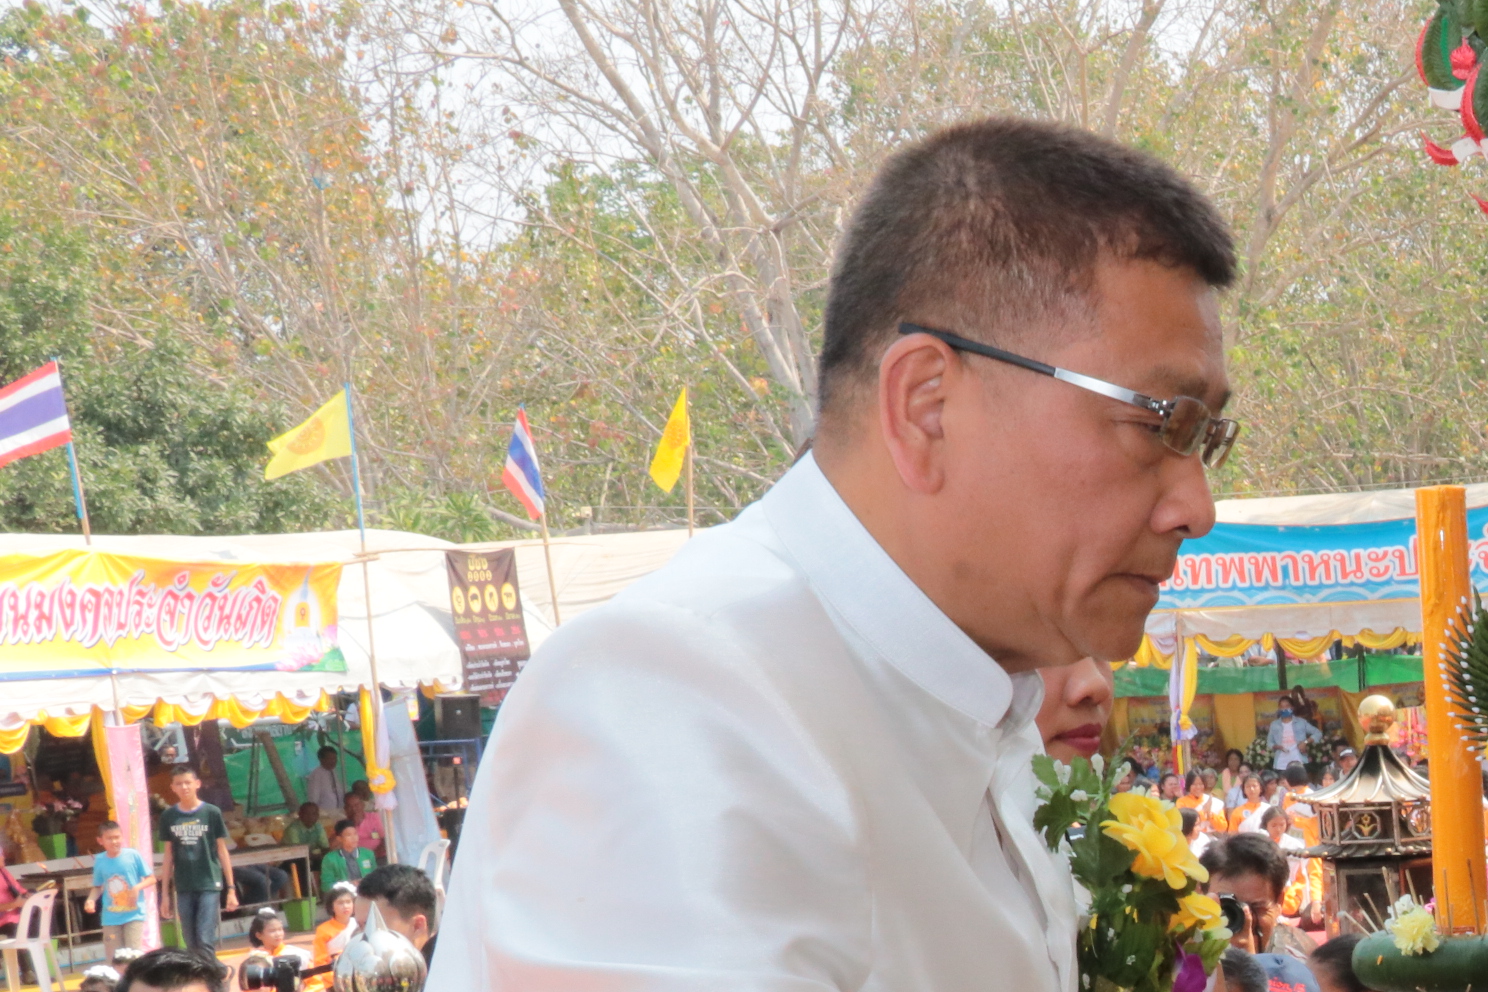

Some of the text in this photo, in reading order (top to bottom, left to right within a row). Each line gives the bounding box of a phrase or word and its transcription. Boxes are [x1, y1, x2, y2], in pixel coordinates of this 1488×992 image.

[0, 569, 282, 650] นมงคลประจำวันเกิด
